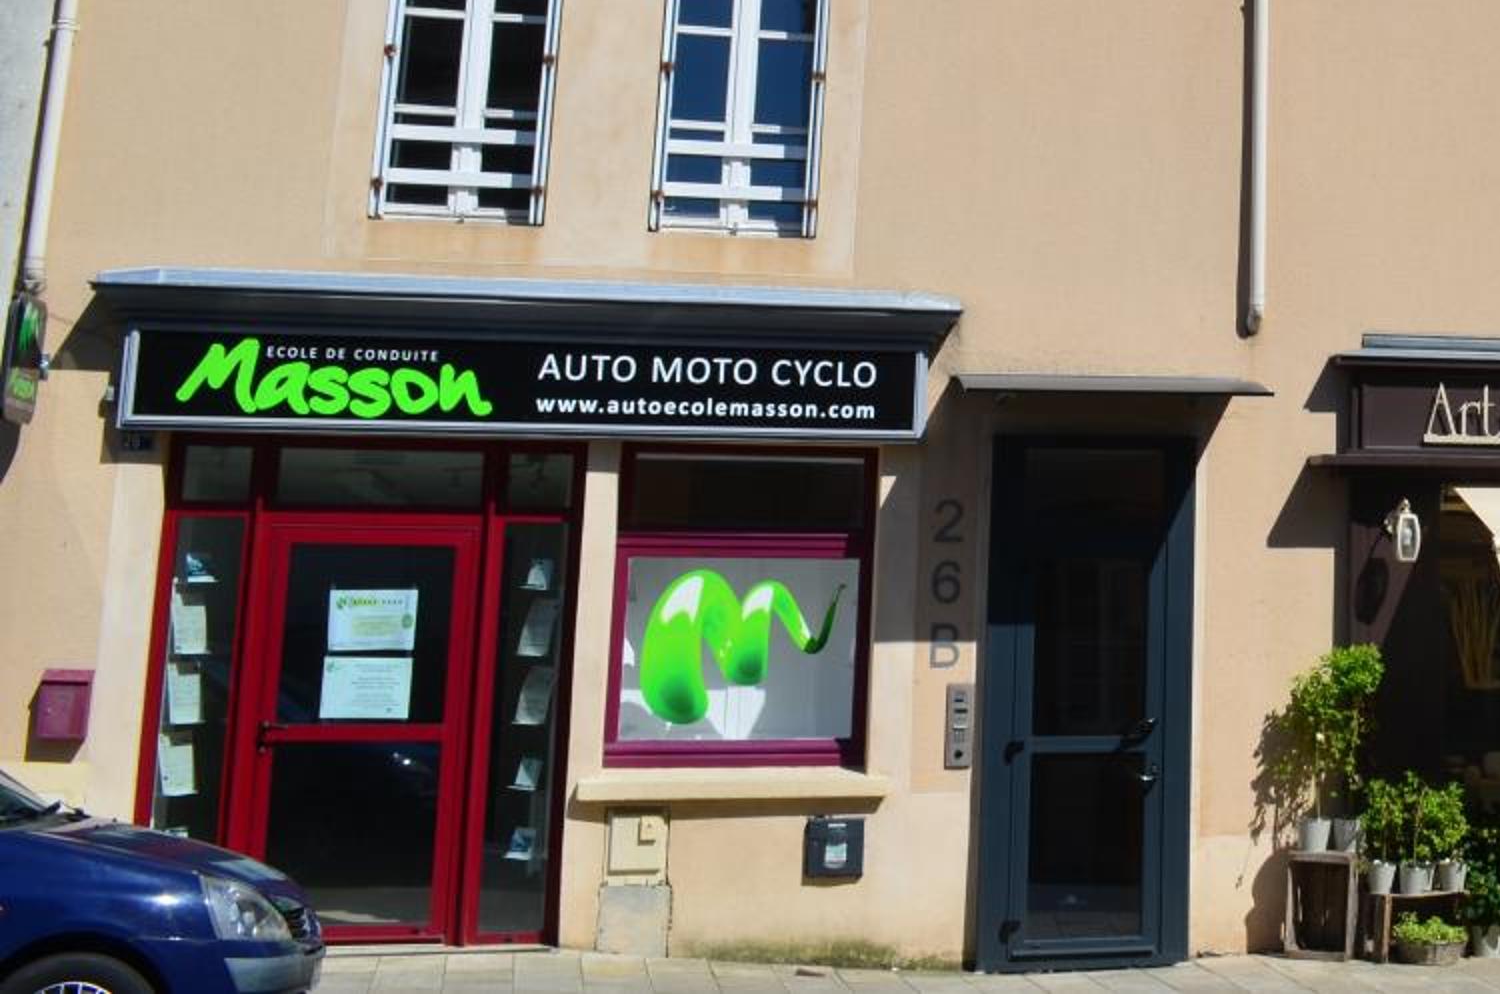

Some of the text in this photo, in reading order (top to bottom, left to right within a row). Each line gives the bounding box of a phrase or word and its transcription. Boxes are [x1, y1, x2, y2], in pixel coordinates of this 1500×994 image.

[266, 345, 439, 362] ECOLE DE CONDUITE
[175, 338, 493, 418] Masson
[537, 353, 878, 389] AUTO MOTO CYCLO
[535, 397, 876, 420] www.autoecolemasson.com
